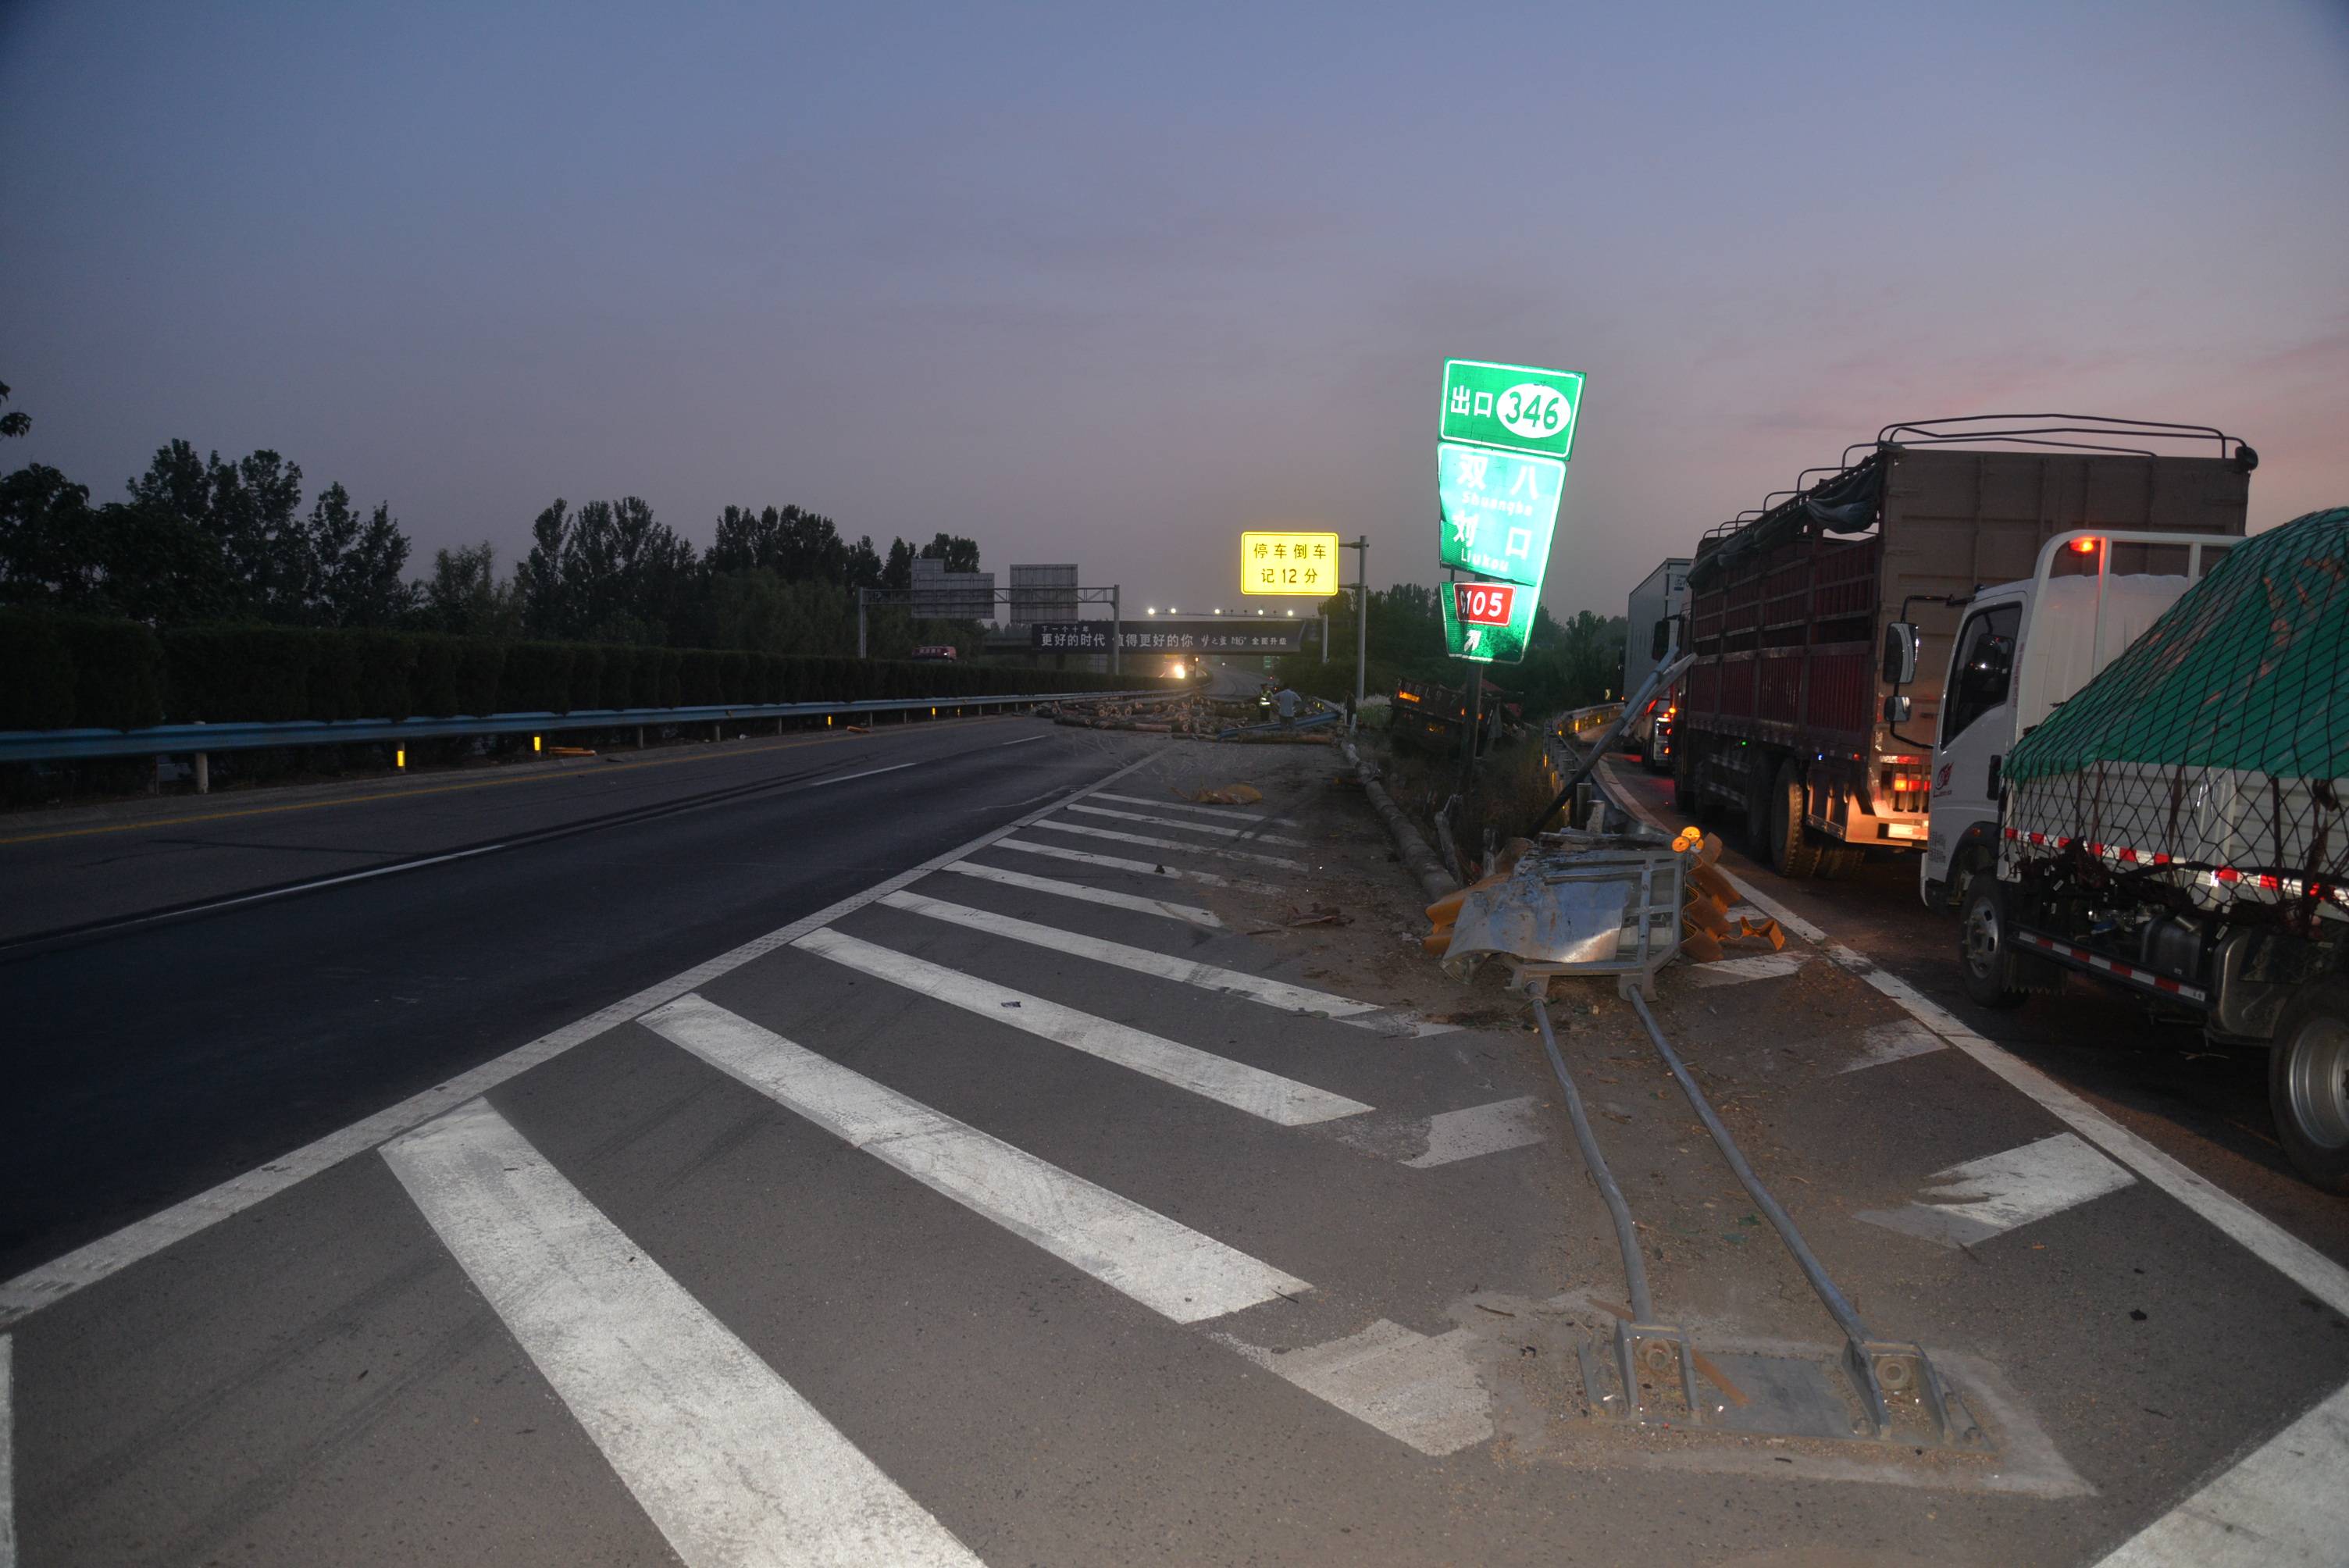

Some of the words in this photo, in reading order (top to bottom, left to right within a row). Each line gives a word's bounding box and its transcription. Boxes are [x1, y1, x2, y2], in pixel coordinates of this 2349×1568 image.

[1450, 384, 1493, 418] 出口
[1505, 391, 1560, 429] 346
[1456, 454, 1538, 500] 双八
[1453, 509, 1532, 560] 刘口
[1253, 543, 1327, 559] 停车倒车
[1261, 568, 1317, 583] 记12分
[1041, 633, 1106, 647] 更好的时代
[1252, 637, 1287, 646] 全面升级
